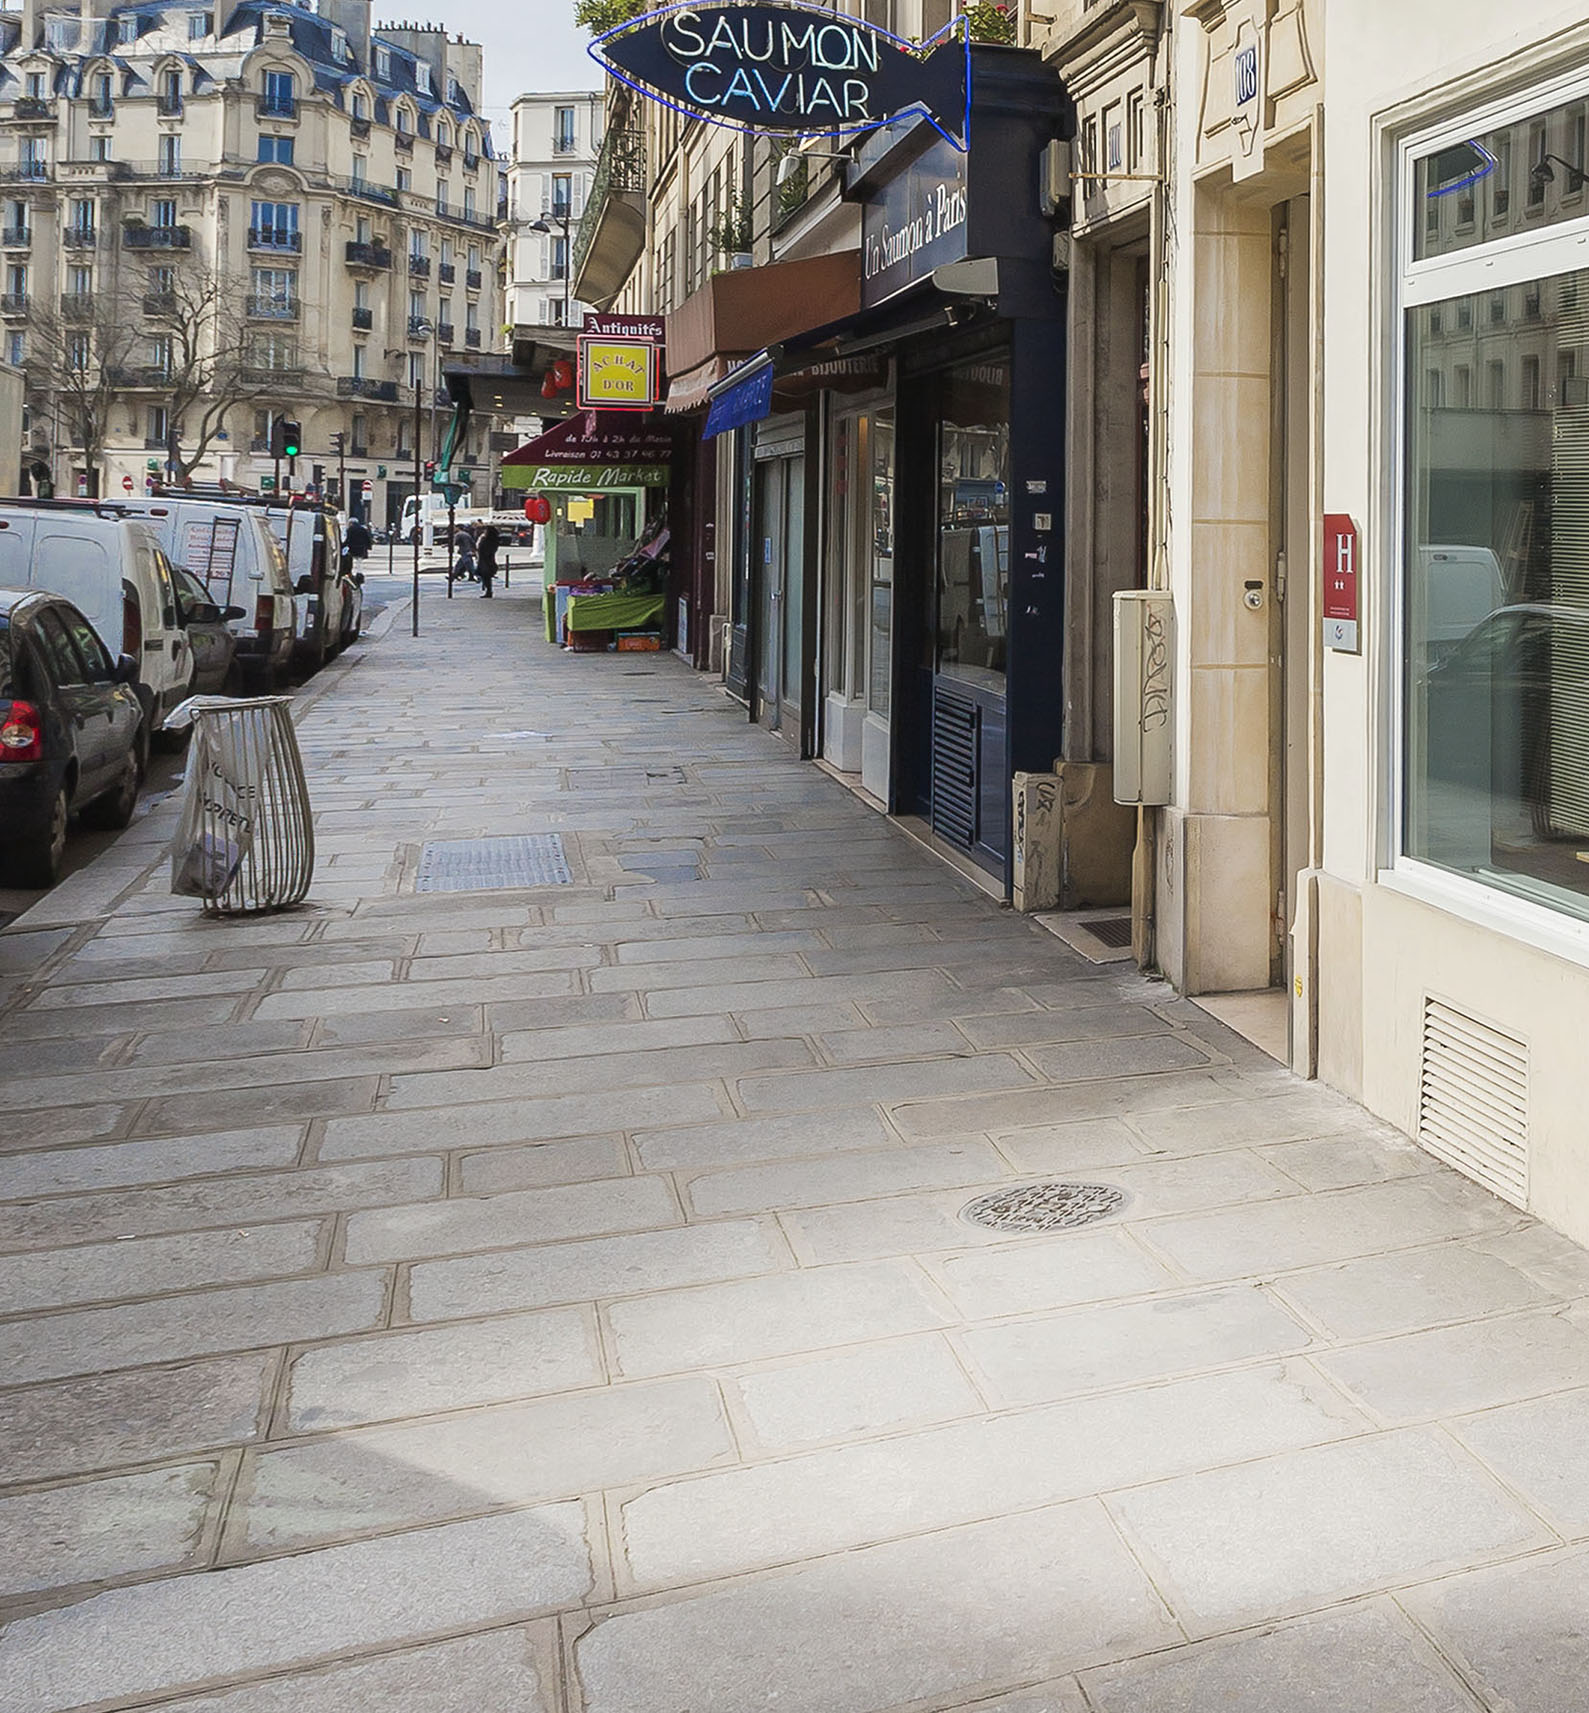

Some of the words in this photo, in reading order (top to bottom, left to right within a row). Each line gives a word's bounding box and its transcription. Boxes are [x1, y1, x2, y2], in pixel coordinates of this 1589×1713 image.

[668, 11, 878, 73] SAUMON
[685, 62, 870, 119] CAVIAR
[1235, 49, 1256, 103] 108
[865, 234, 880, 280] Un
[880, 217, 923, 271] Saumon
[925, 193, 933, 244] à
[935, 171, 967, 238] Paris
[586, 316, 663, 337] Antiquités
[591, 354, 646, 376] ACHAT
[603, 379, 634, 392] D'OR
[544, 449, 586, 459] Livraison
[531, 467, 592, 487] Rapide
[597, 467, 662, 487] Market
[1335, 533, 1353, 574] H
